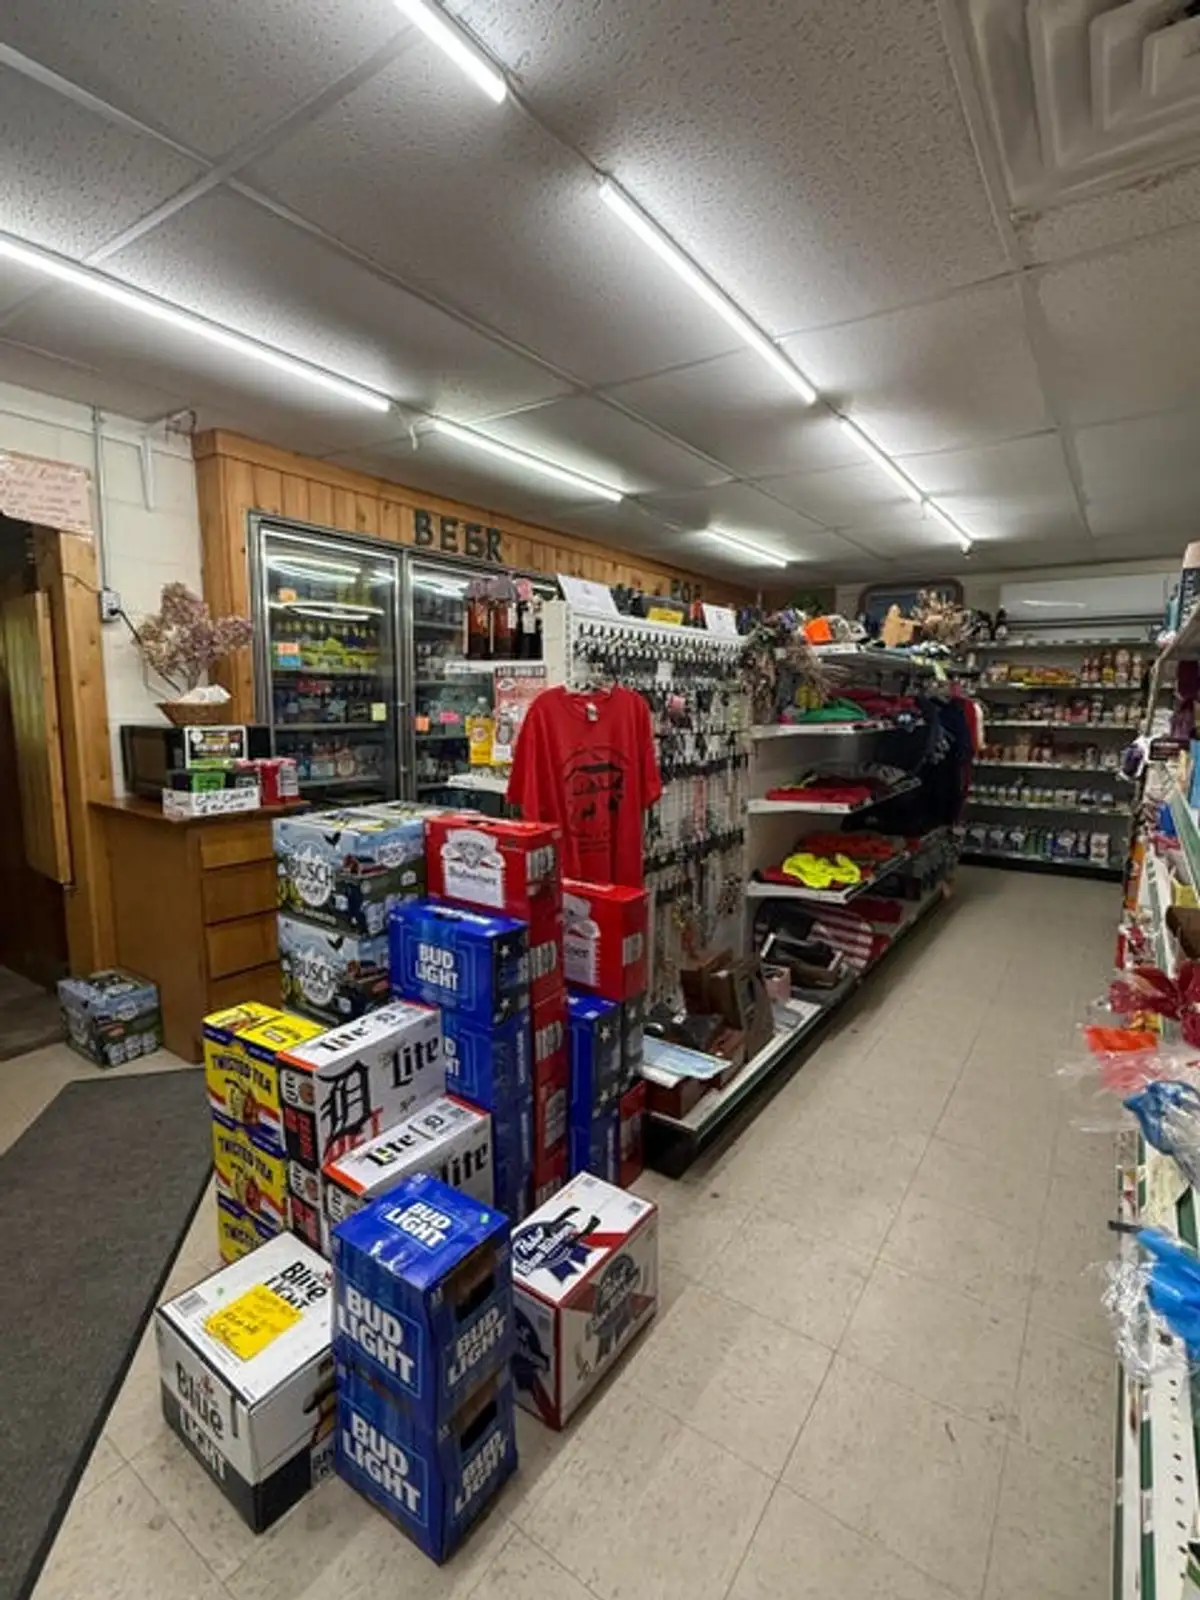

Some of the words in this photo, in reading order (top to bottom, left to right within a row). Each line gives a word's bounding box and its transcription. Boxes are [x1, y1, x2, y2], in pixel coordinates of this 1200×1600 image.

[414, 960, 459, 992] LIGHT
[418, 942, 455, 968] BUD
[319, 1020, 367, 1052] Lite
[392, 1037, 440, 1089] Lite
[386, 1208, 450, 1247] LIGHT
[409, 1202, 453, 1230] BUD
[279, 1260, 328, 1302] Blue
[345, 1286, 405, 1345] BUD
[456, 1306, 506, 1351] BUD
[337, 1304, 416, 1386] LIGHT
[447, 1318, 506, 1388] LIGHT
[175, 1360, 224, 1441] Blue
[350, 1411, 409, 1475] BUD
[461, 1430, 508, 1484] BUD
[341, 1430, 422, 1512] LIGHT
[454, 1446, 505, 1514] LIGHT
